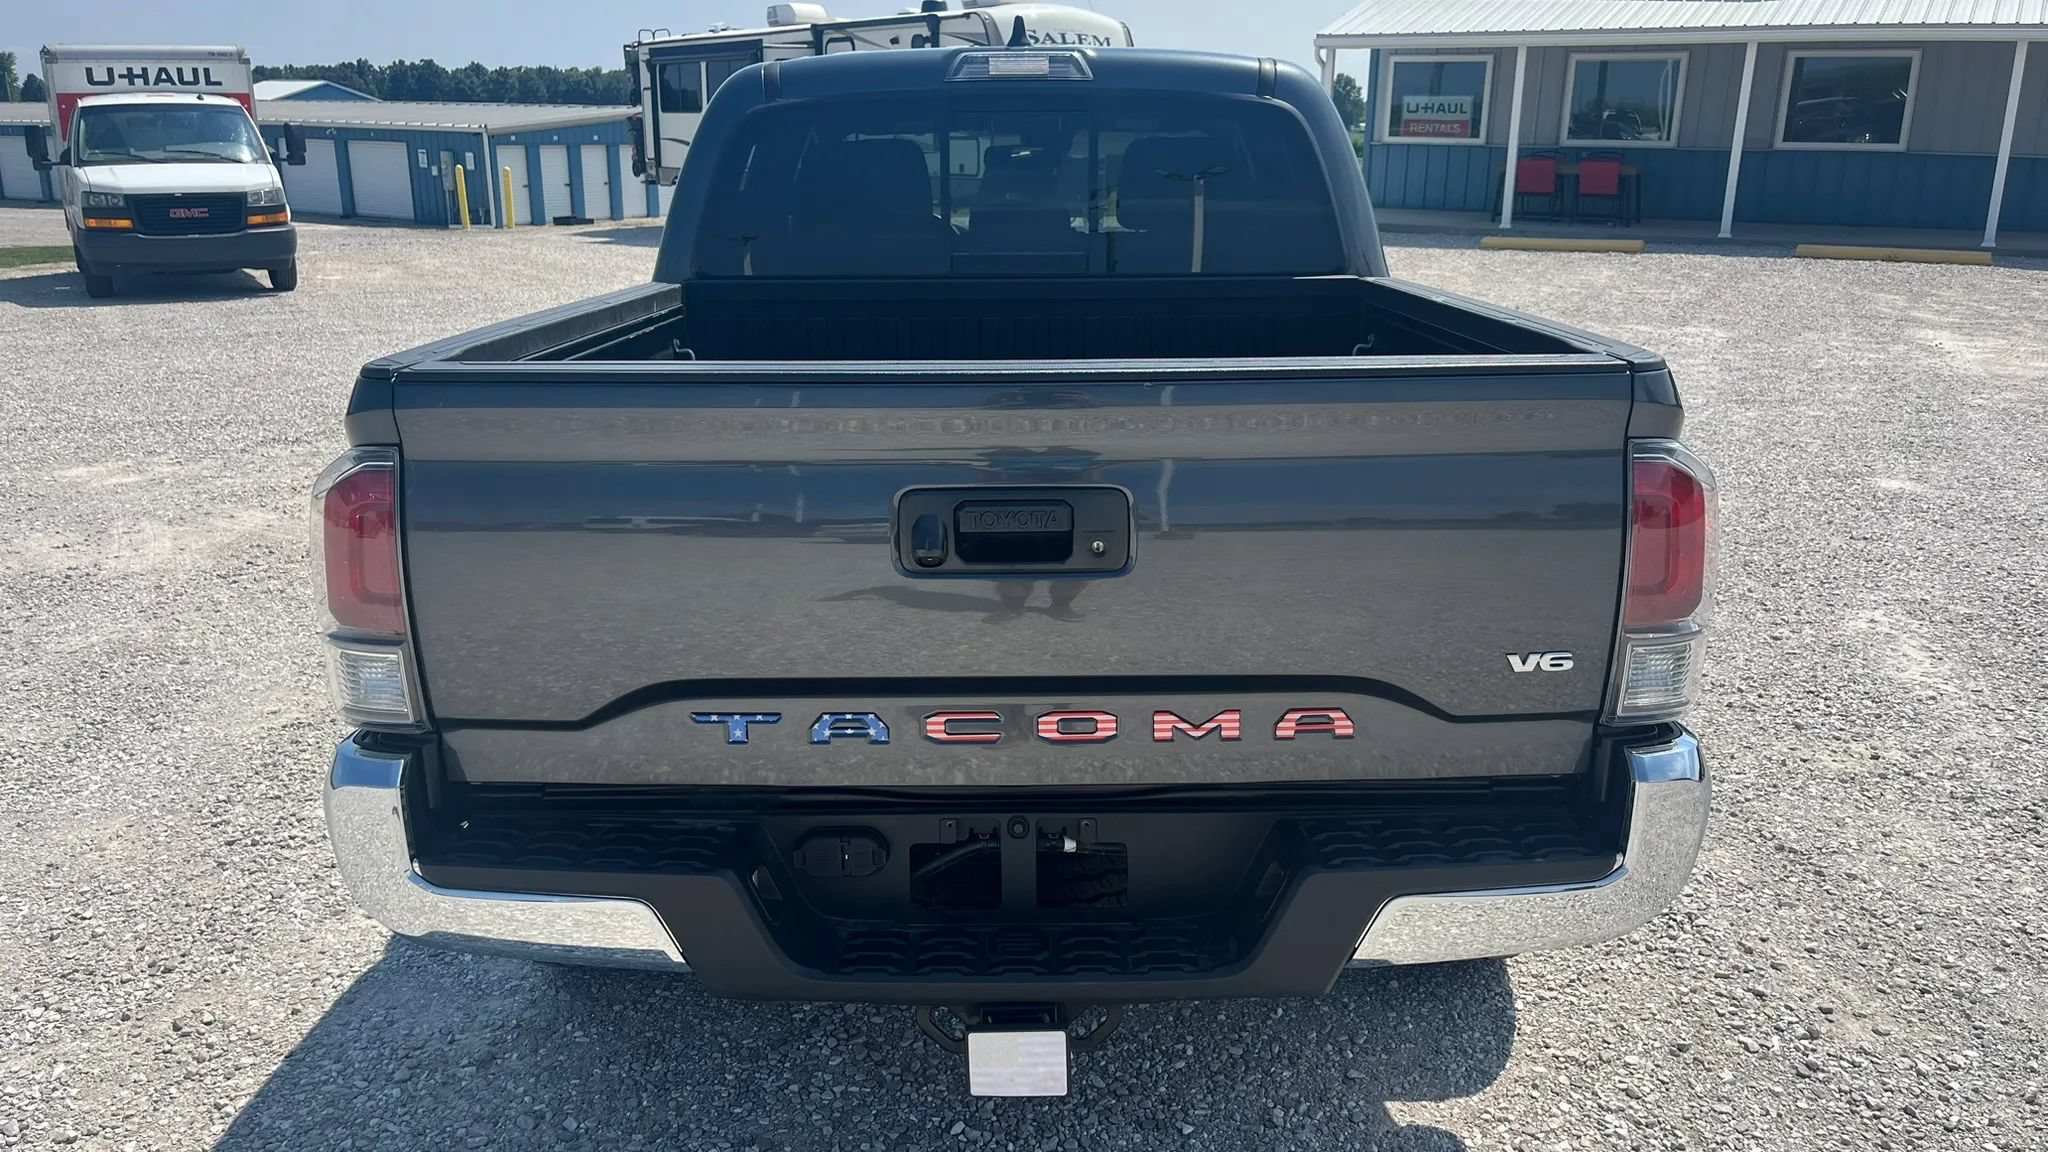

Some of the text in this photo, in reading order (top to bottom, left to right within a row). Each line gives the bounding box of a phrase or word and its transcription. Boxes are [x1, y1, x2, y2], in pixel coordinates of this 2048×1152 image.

[1025, 29, 1111, 47] SALEM
[85, 67, 223, 86] U-HAUL
[1406, 102, 1468, 114] U-HAUL
[1409, 122, 1460, 133] RENTALS
[169, 207, 209, 218] GMC
[967, 510, 1063, 529] TOYOTA
[1505, 651, 1574, 672] V6
[690, 708, 1355, 745] TACOMA
